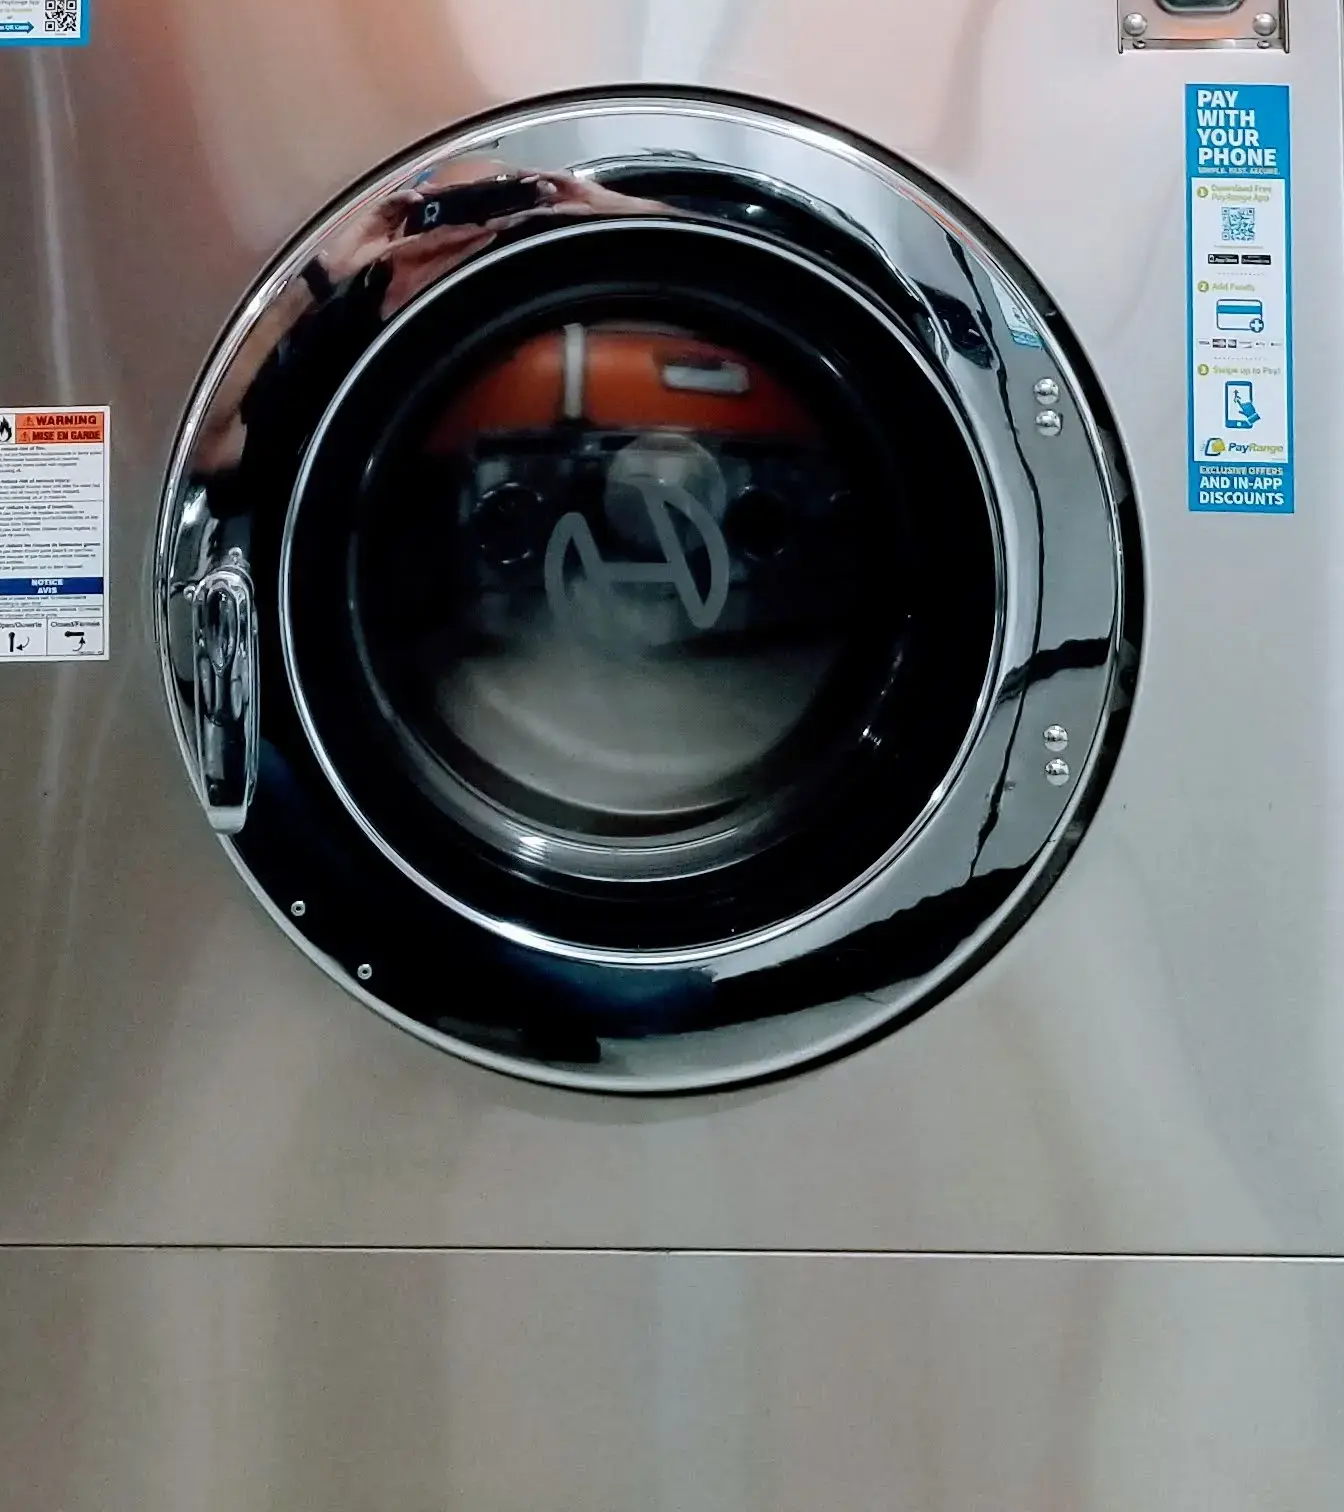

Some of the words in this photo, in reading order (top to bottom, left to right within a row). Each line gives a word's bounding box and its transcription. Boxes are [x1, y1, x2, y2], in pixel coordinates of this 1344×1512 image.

[1197, 89, 1239, 108] PAY
[1197, 109, 1255, 128] WITH
[1197, 128, 1260, 147] YOUR
[1198, 148, 1277, 167] PHONE
[36, 414, 97, 426] WARNING
[32, 431, 54, 441] MISE
[57, 431, 69, 440] EN
[71, 430, 101, 440] GARDE
[1228, 443, 1284, 455] PayRange
[1199, 476, 1230, 489] AND
[1233, 476, 1283, 490] IN-APP
[1199, 491, 1285, 505] DISCOUNTS
[31, 578, 64, 586] NOTICE
